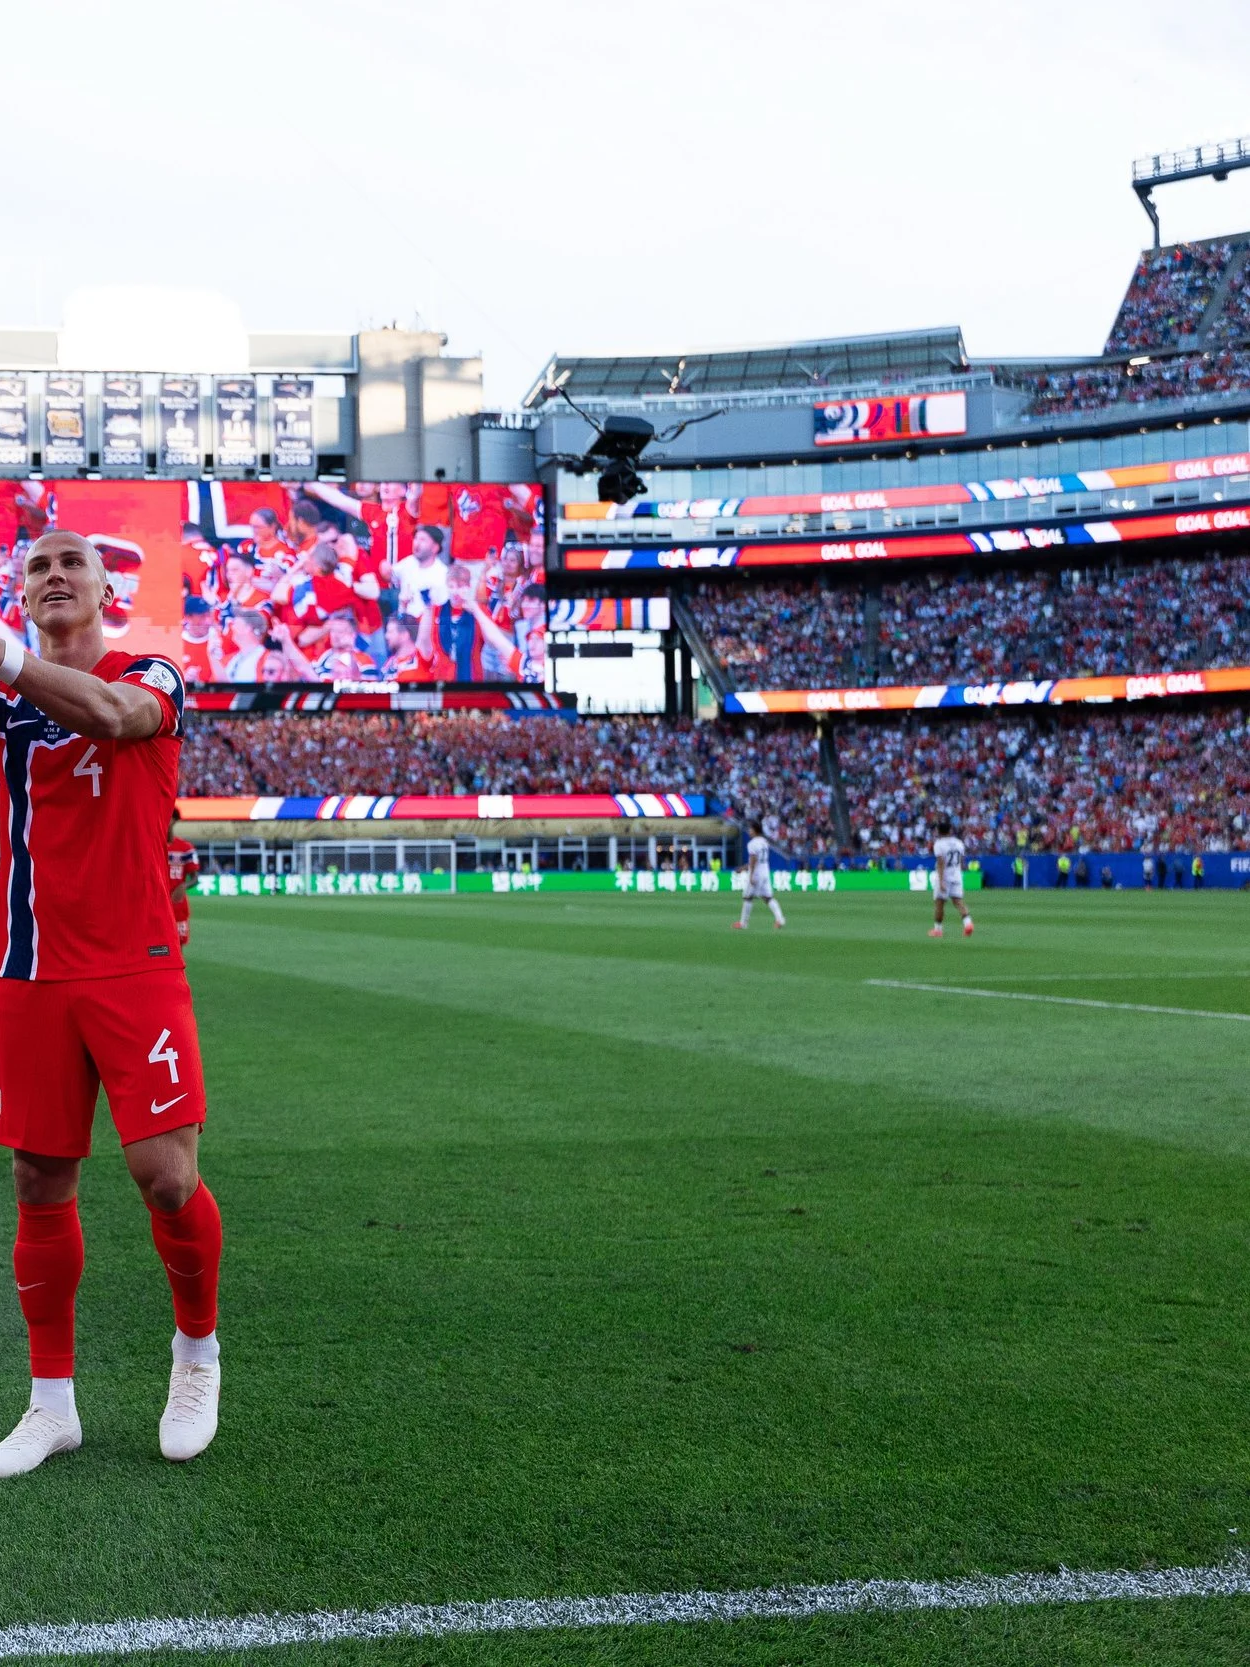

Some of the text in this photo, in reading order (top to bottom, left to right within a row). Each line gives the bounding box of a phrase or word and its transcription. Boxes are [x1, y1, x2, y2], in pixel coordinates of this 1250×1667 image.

[1175, 457, 1249, 480] GOAL GOAL
[821, 493, 887, 511] GOAL GOAL
[1175, 511, 1250, 533] GOAL GOAL
[821, 542, 887, 560] GOAL GOAL
[1126, 674, 1205, 697] GOAL GOAL
[807, 691, 880, 709] GOAL GOAL
[73, 744, 102, 797] 4
[1230, 857, 1250, 873] FIF
[731, 870, 837, 892] 试软牛奶
[147, 1028, 179, 1084] 4
